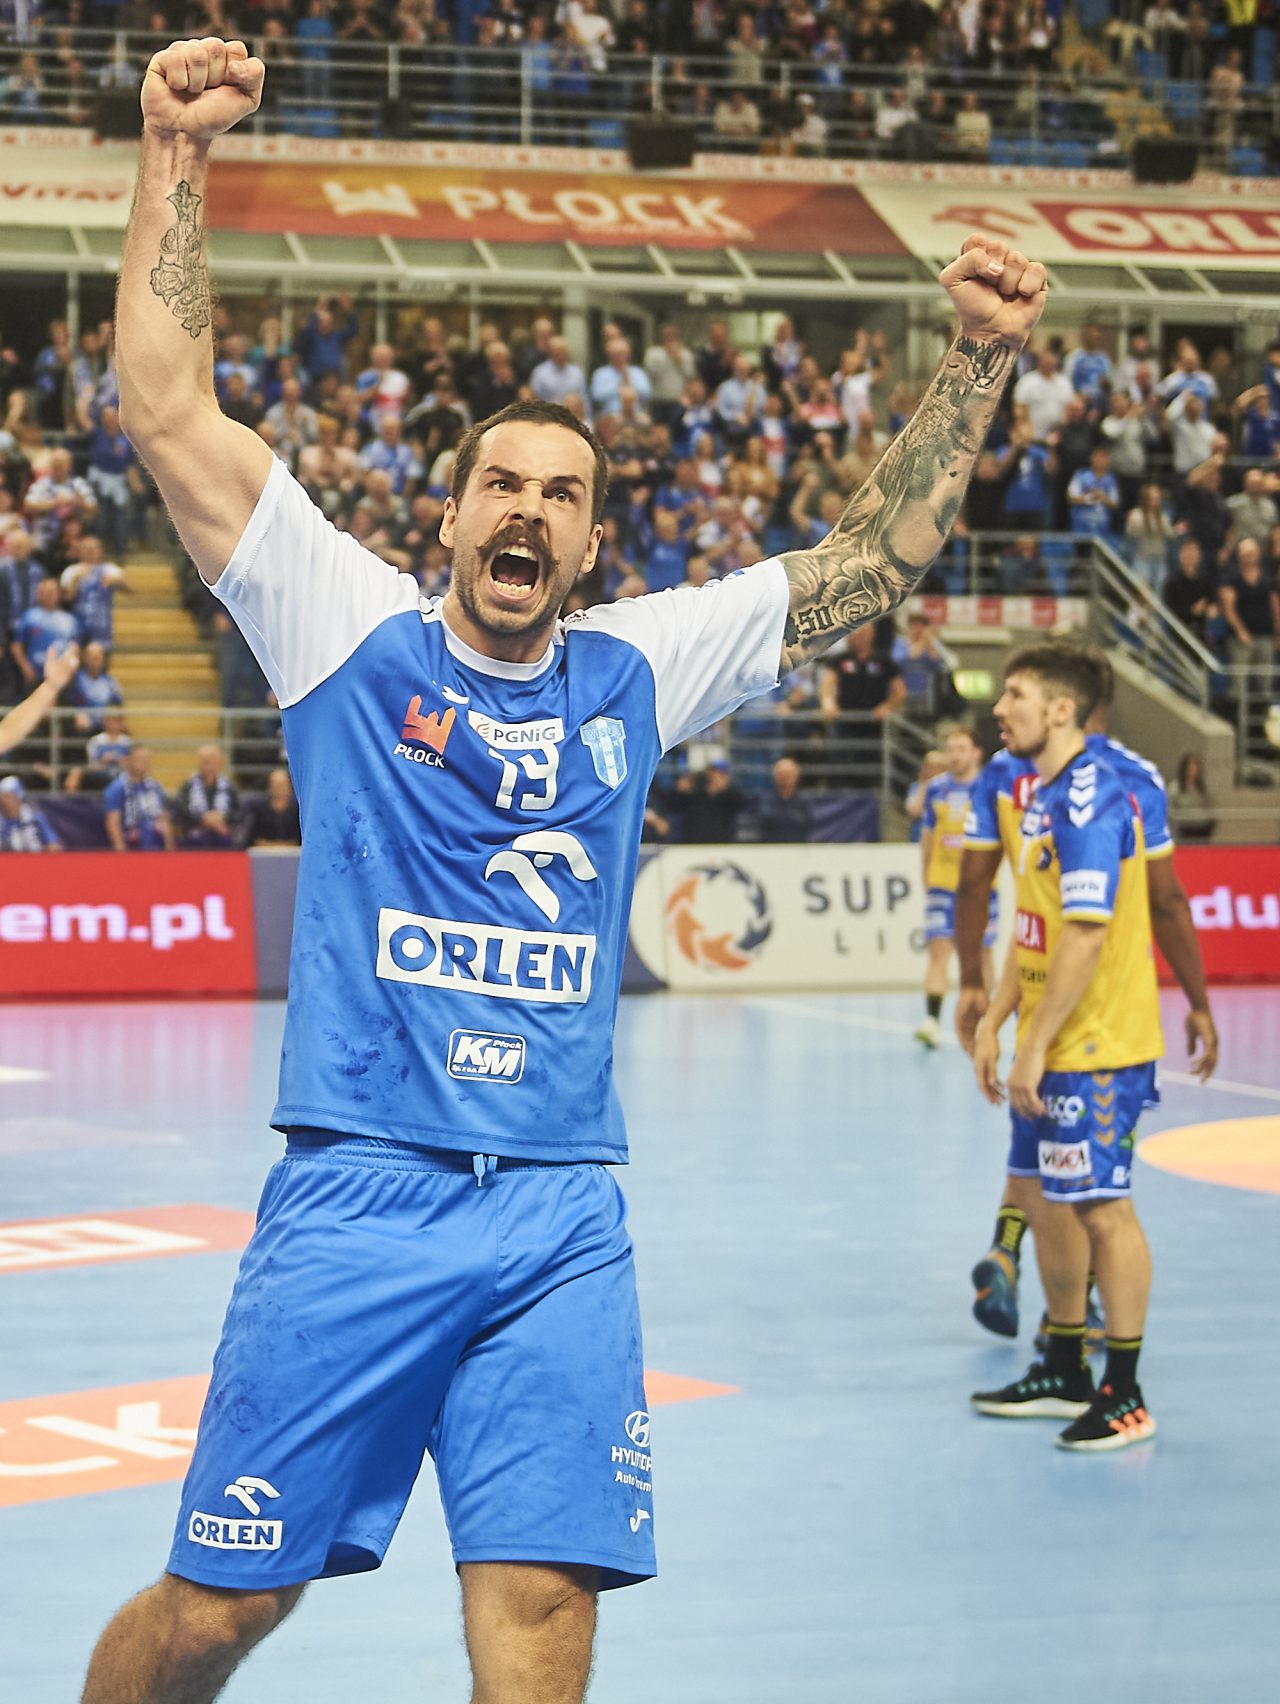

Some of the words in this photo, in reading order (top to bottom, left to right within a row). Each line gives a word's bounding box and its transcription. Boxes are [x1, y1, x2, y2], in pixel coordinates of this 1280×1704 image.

[443, 185, 755, 240] PŁOCK
[493, 726, 556, 743] PGNiG
[393, 743, 445, 768] PŁOCK
[389, 924, 587, 993] ORLEN
[452, 1035, 522, 1077] KM
[192, 1517, 274, 1545] ORLEN
